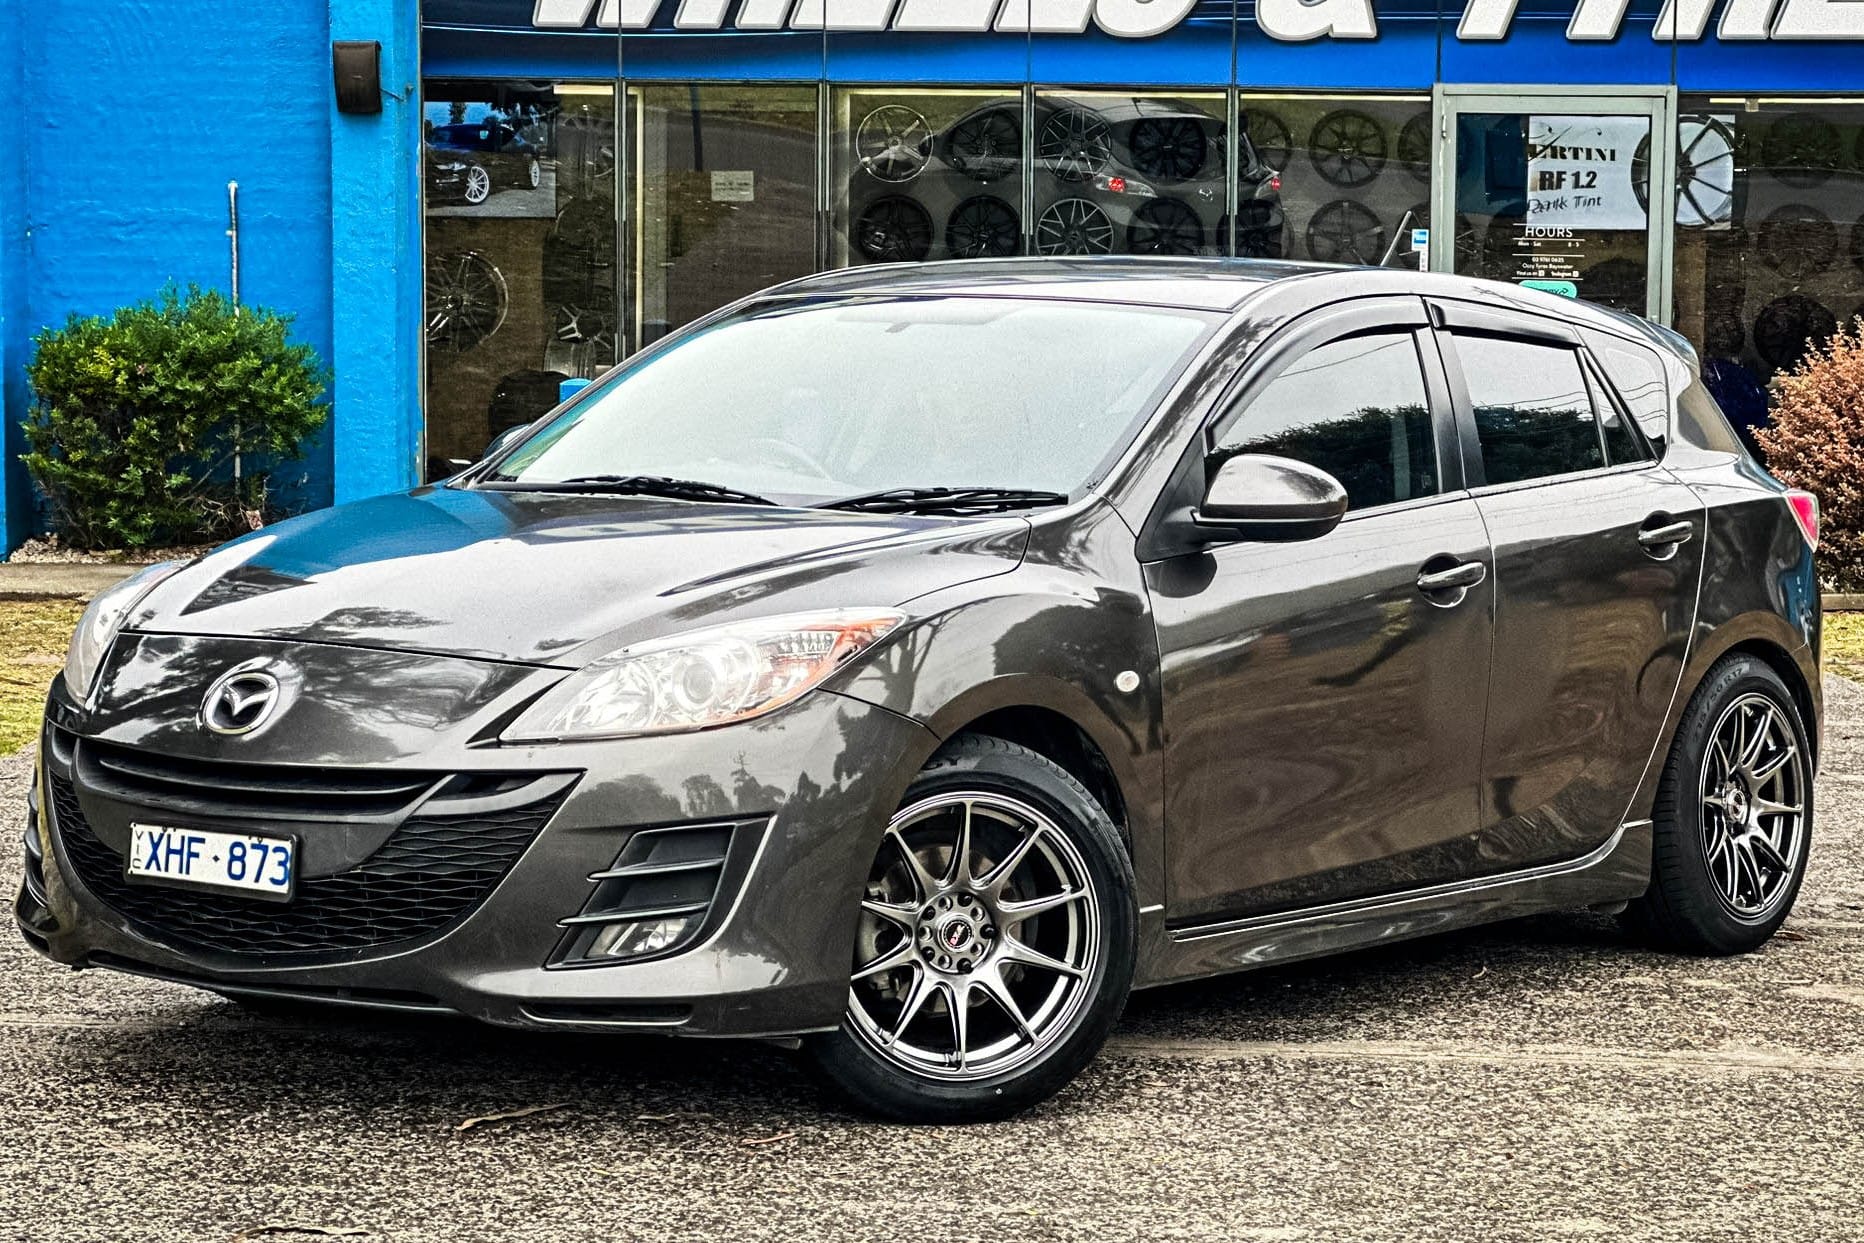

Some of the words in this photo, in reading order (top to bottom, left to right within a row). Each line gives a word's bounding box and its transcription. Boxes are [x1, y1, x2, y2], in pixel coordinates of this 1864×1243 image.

[1539, 171, 1567, 191] RF
[1571, 171, 1598, 189] 1.2
[1574, 196, 1602, 209] Tint
[1525, 226, 1573, 238] HOURS
[132, 830, 144, 869] VIC
[144, 831, 206, 875] XHF
[227, 841, 290, 886] 873
